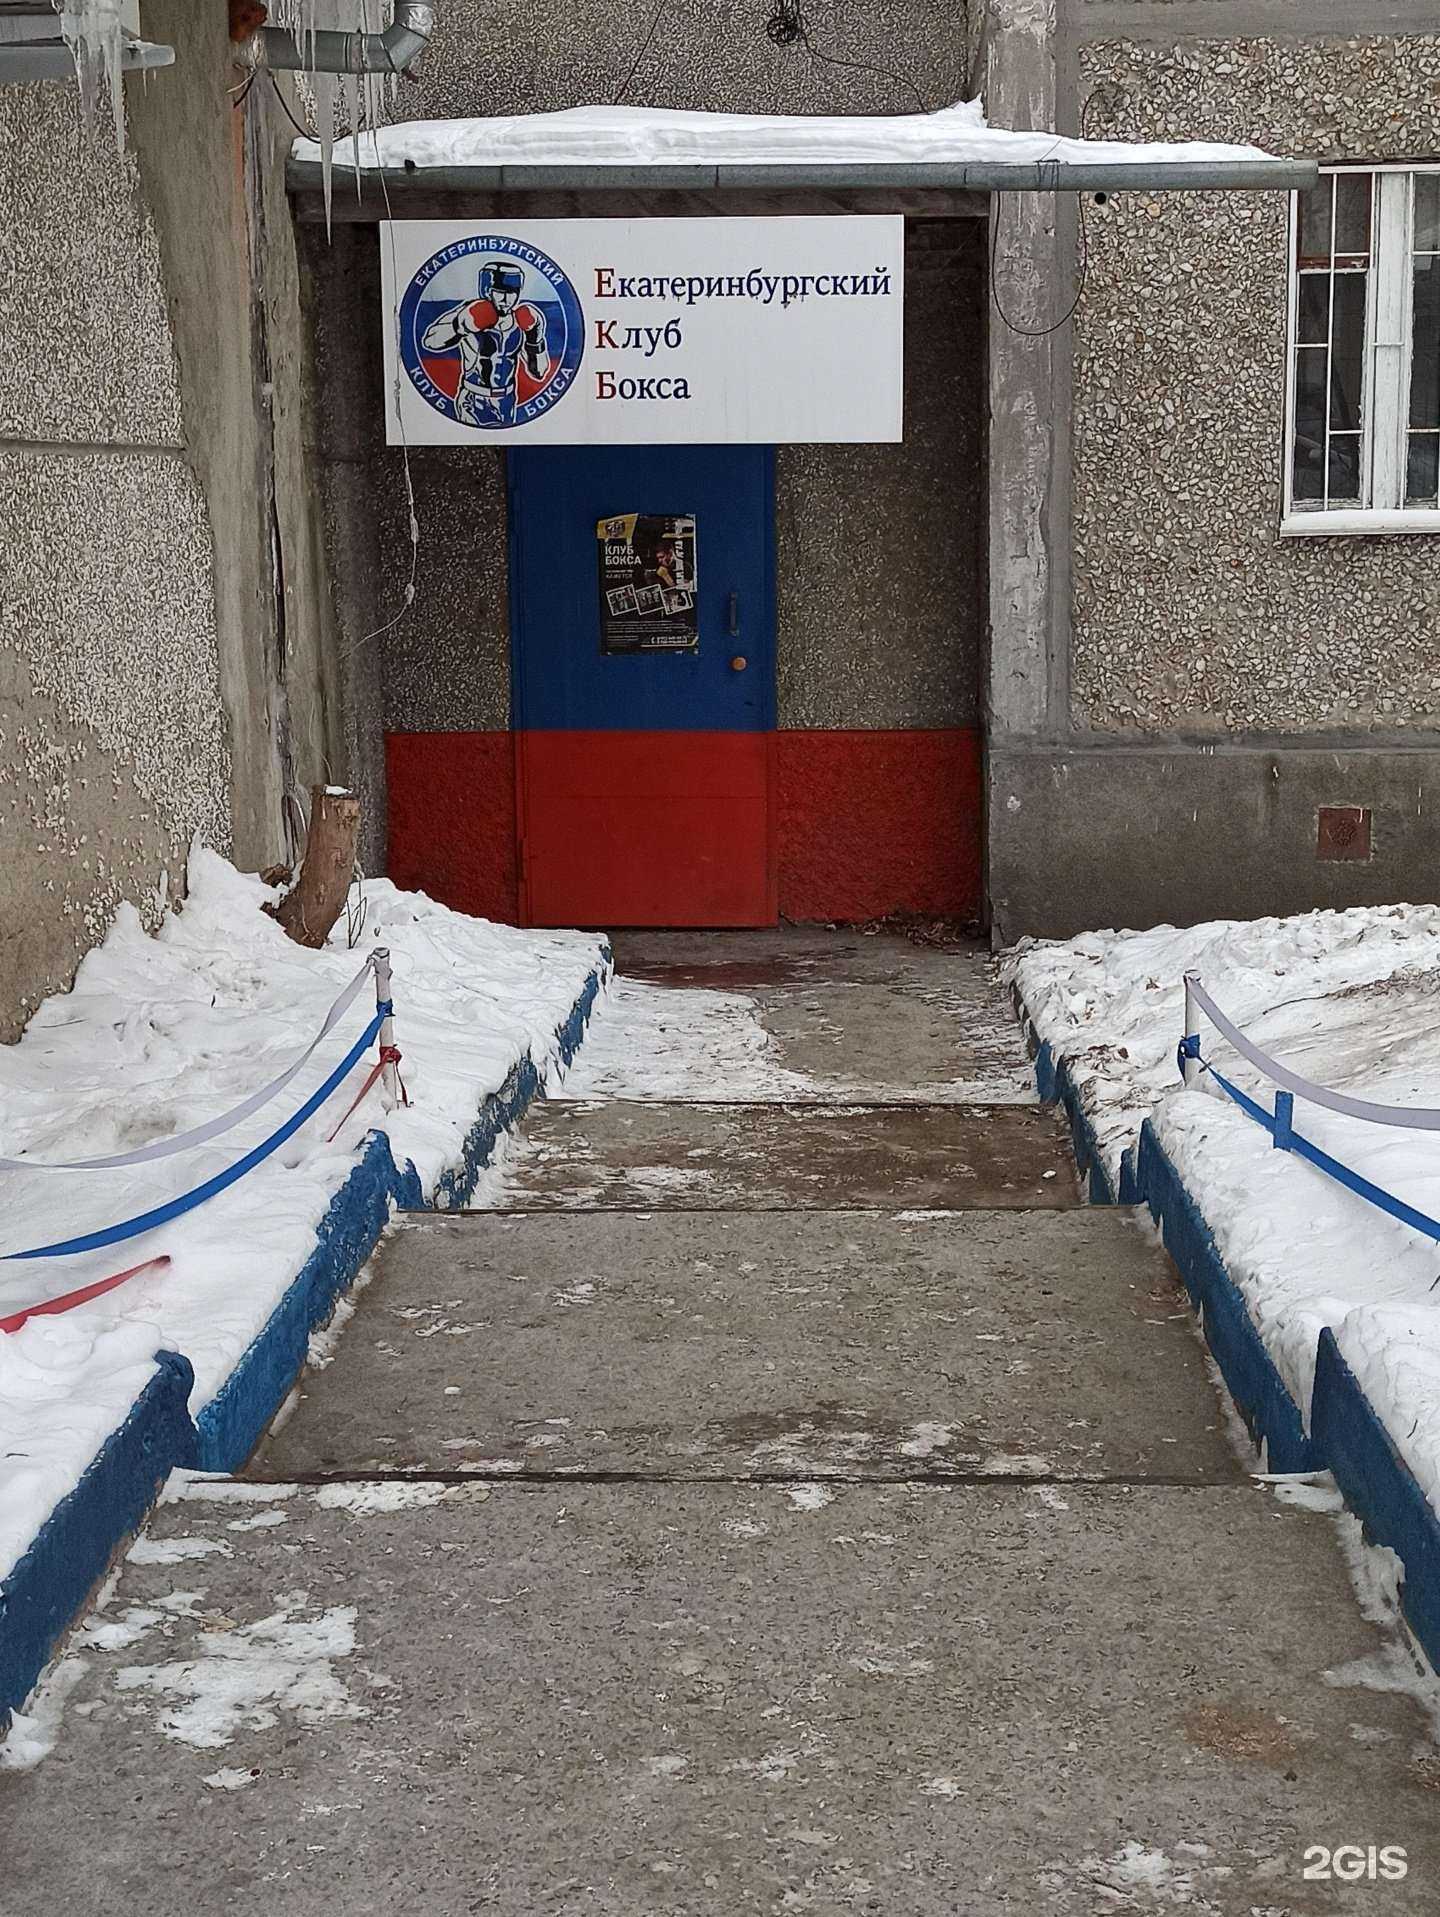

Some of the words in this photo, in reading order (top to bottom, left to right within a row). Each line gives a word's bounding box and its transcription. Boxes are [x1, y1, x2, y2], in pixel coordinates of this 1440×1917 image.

[414, 238, 564, 287] ЕКАТЕРИНБУРГСКИЙ
[594, 267, 892, 306] Екатеринбургский
[595, 318, 682, 357] Клуб
[409, 366, 448, 411] КЛУБ
[524, 366, 574, 417] БОКСА
[595, 371, 691, 400] Бокса
[605, 544, 635, 555] КЛУБ
[605, 555, 642, 565] БОКСА
